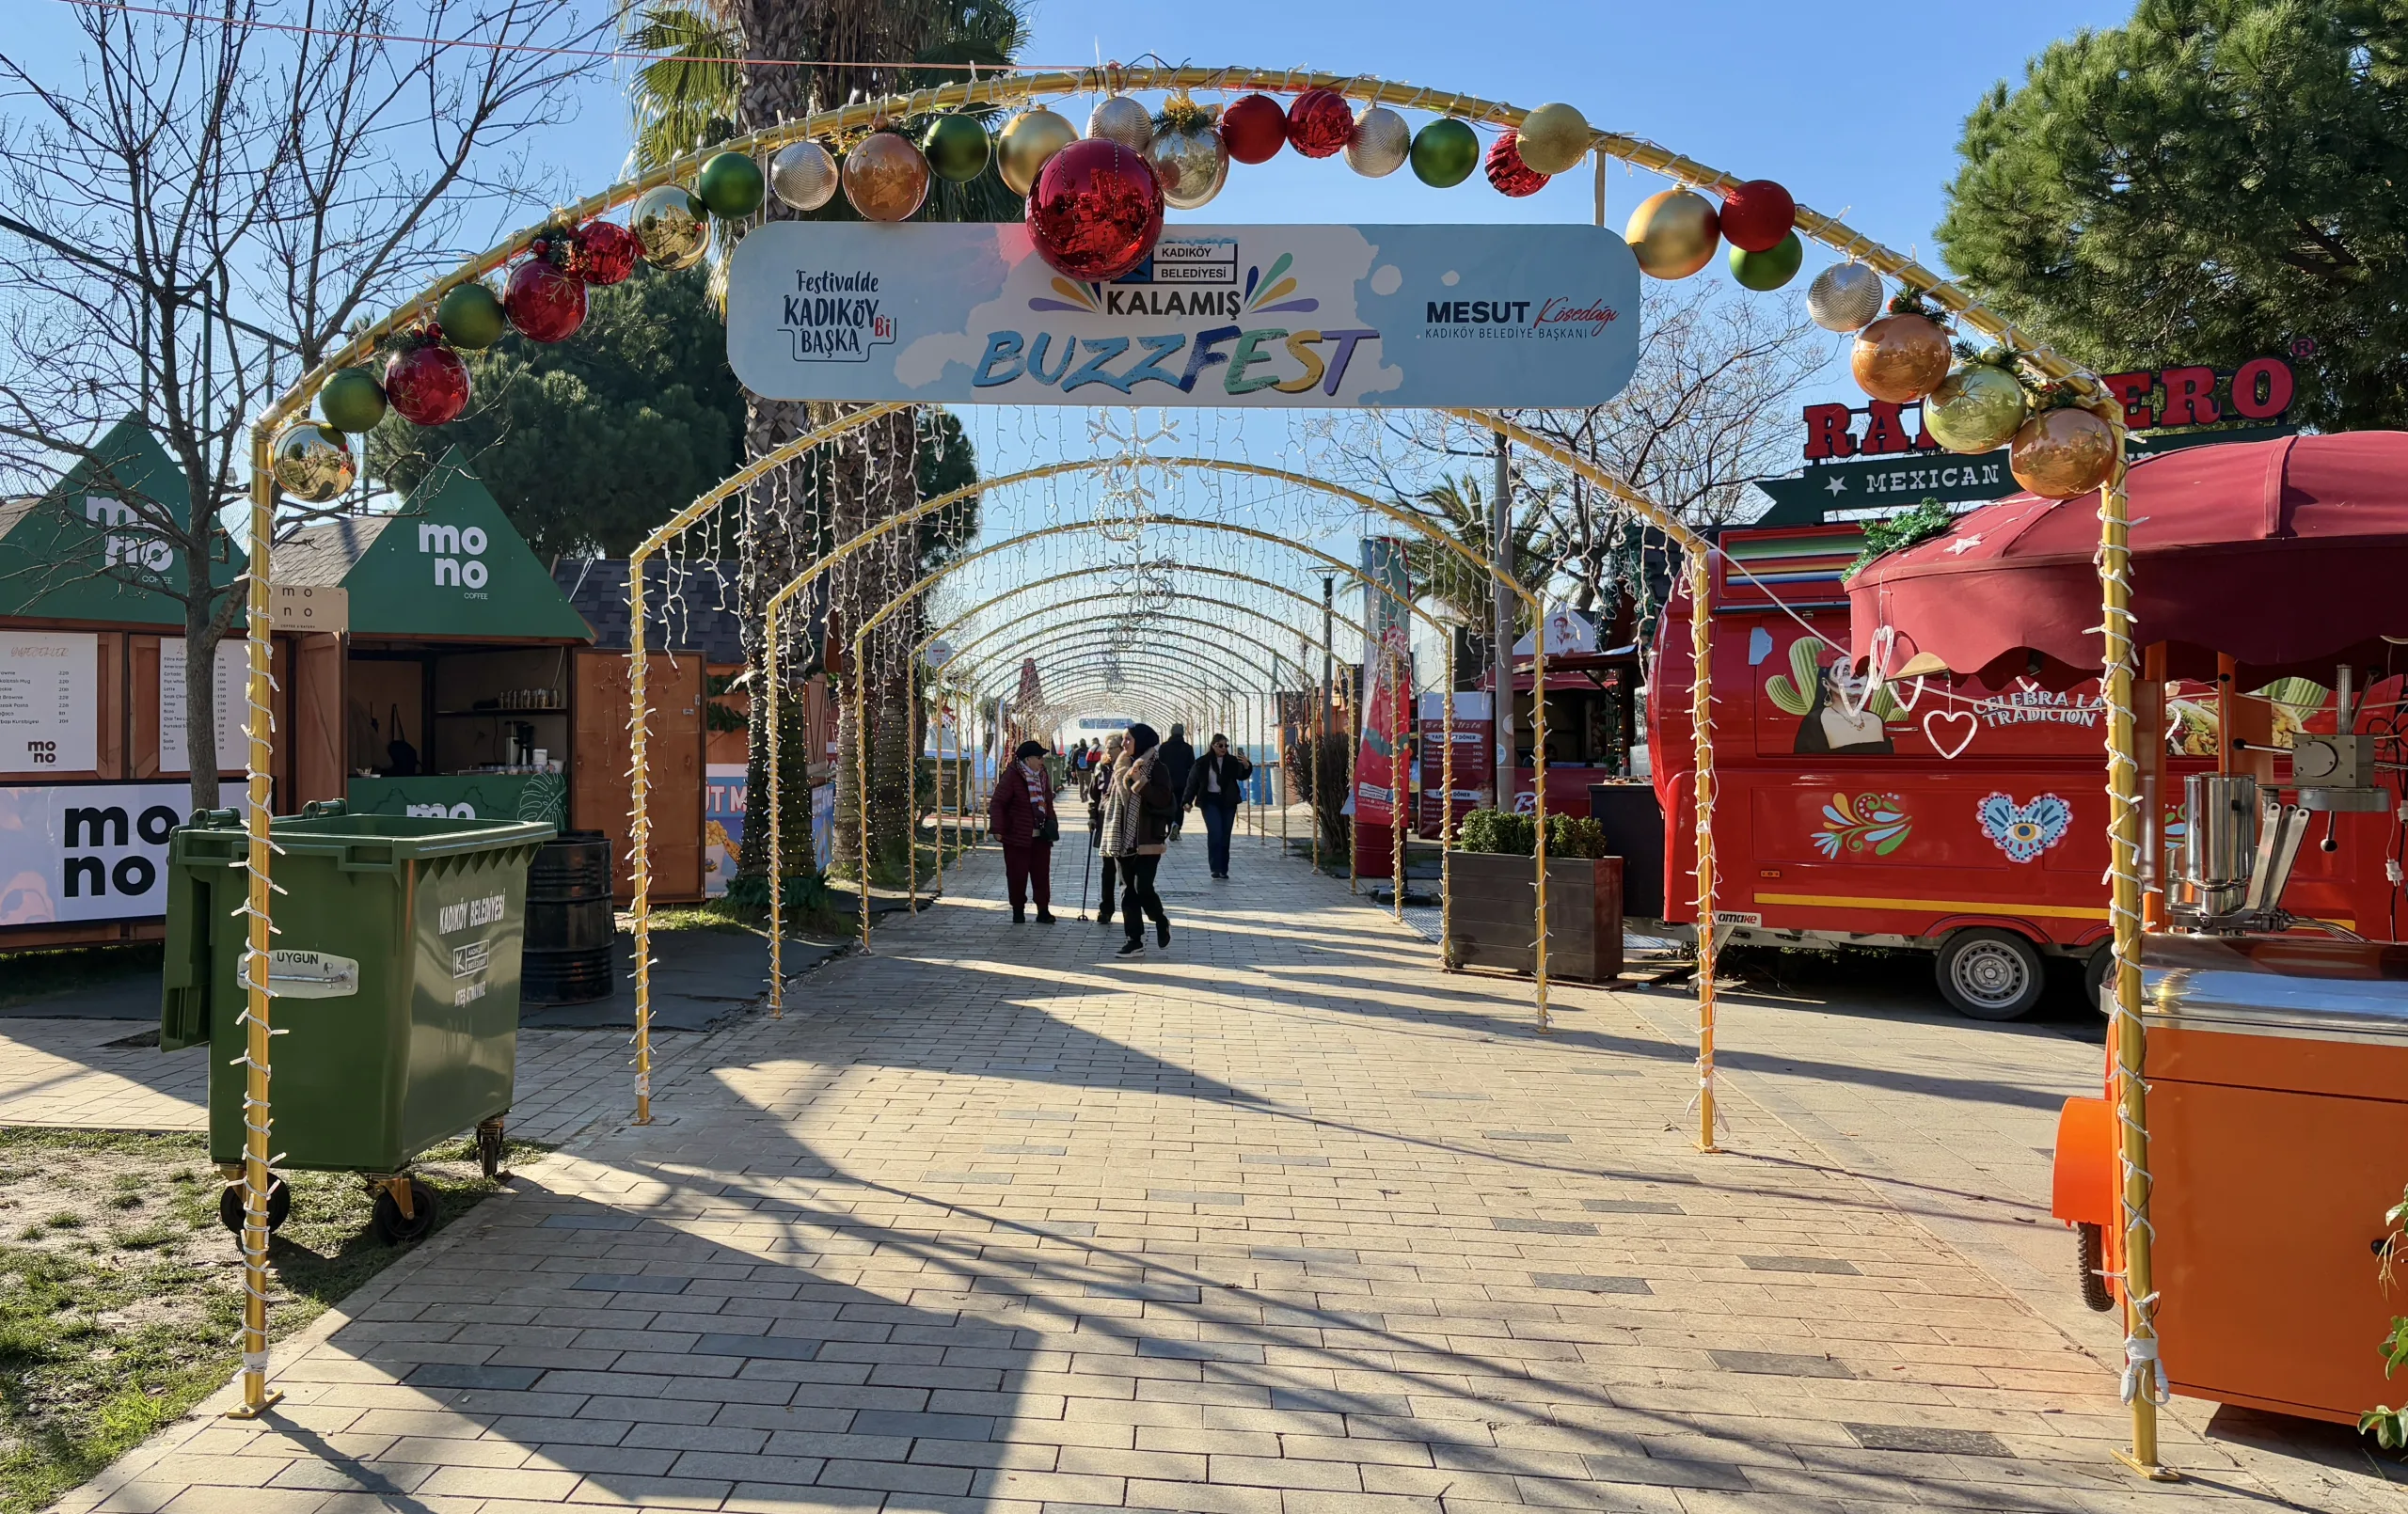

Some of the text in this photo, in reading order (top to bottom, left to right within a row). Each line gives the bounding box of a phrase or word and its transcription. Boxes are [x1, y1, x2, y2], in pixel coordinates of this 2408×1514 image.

[1162, 245, 1212, 258] KADIKÖY
[796, 269, 879, 294] Festivalde
[1161, 266, 1227, 278] BELEDİYESİ
[784, 294, 879, 329] KADIKÖY
[1107, 291, 1242, 321] KALAMIŞ
[1427, 296, 1621, 337] MESUT Kösedağı
[800, 328, 862, 358] BAŞKA
[1425, 325, 1588, 341] KADIKÖY BELEDİYE BAŞKANI
[972, 324, 1380, 397] BUZZFEST
[1866, 465, 1999, 494] MEXICAN
[419, 524, 488, 555] mo
[142, 576, 173, 584] COFEE
[435, 558, 488, 589] no
[1973, 691, 2068, 715] CELEBRA
[27, 741, 56, 751] mo
[33, 752, 56, 764] no
[64, 805, 180, 847] mo
[64, 855, 156, 898] no
[438, 888, 506, 935] KADIKÖY BELEDİYESİ
[1719, 913, 1757, 924] omake
[277, 952, 319, 965] UYGUN
